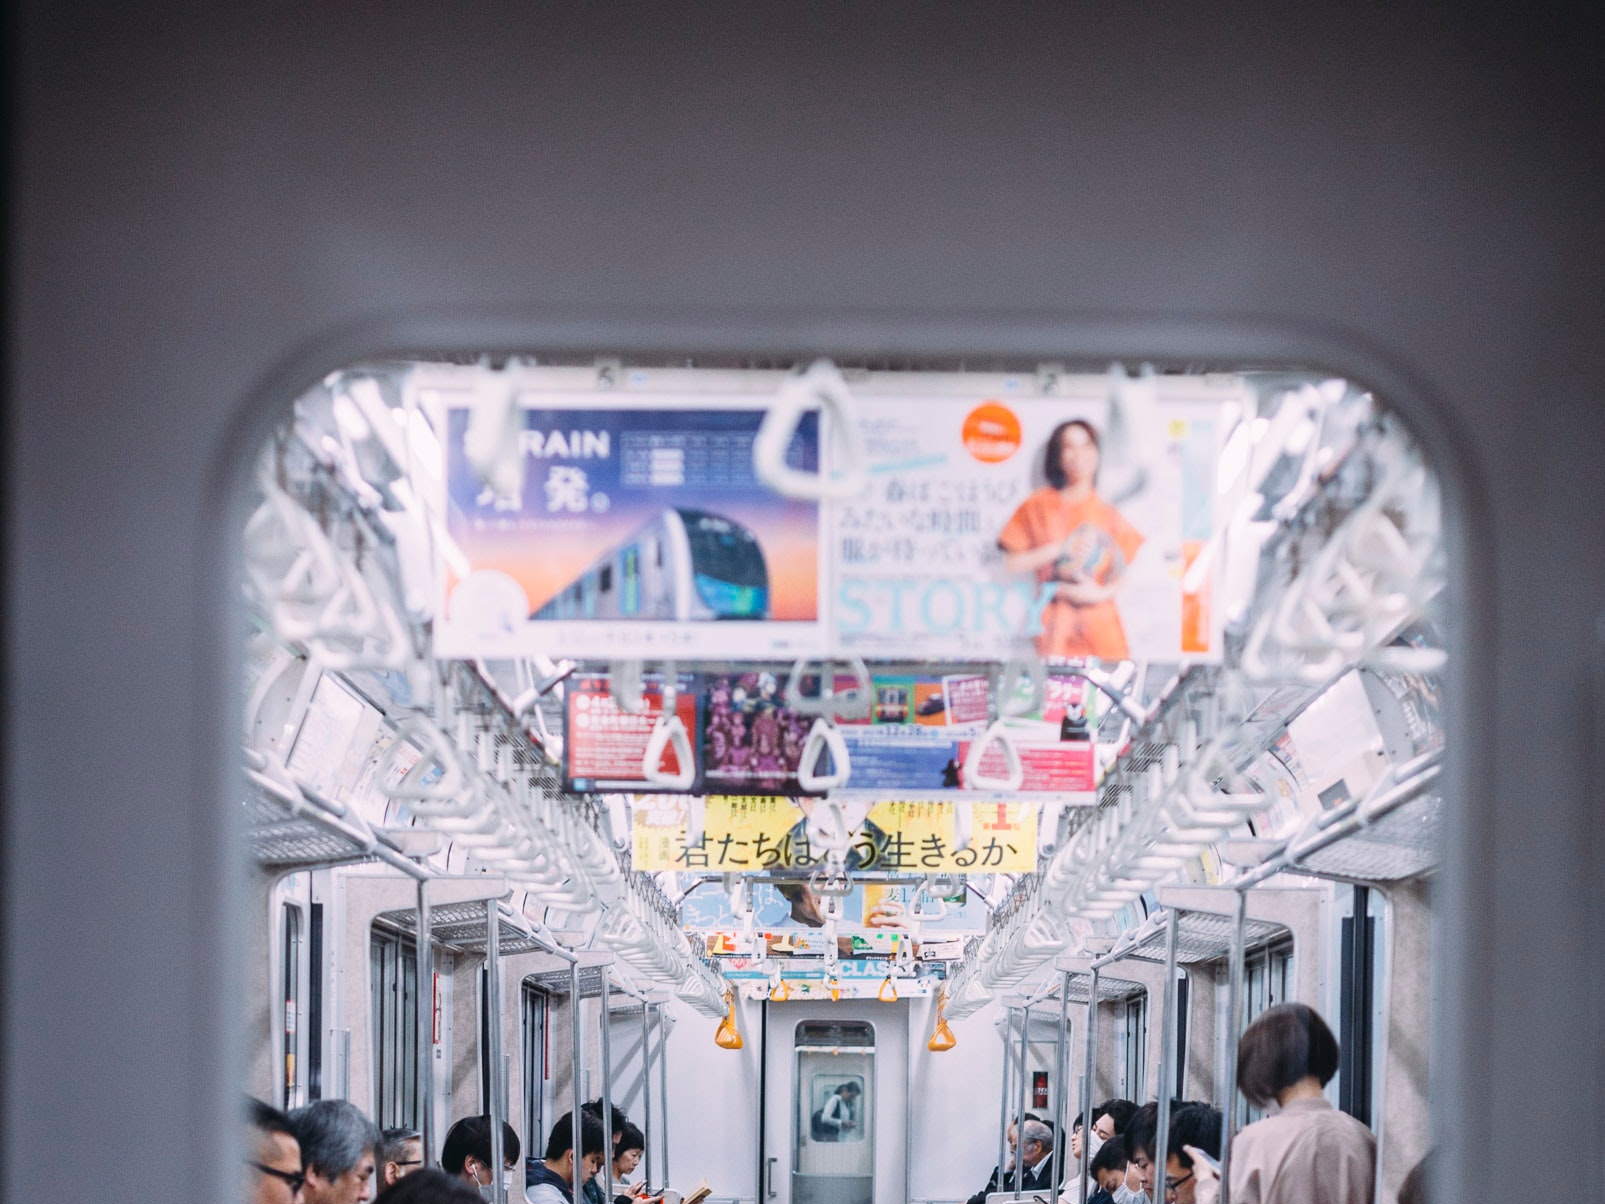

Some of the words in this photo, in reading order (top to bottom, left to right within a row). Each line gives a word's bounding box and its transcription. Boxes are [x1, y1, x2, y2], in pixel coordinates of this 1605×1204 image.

[497, 429, 612, 460] RAIN
[838, 578, 1058, 634] STORY
[675, 830, 1018, 869] 君たちはう生きるか
[840, 960, 893, 978] CLAS
